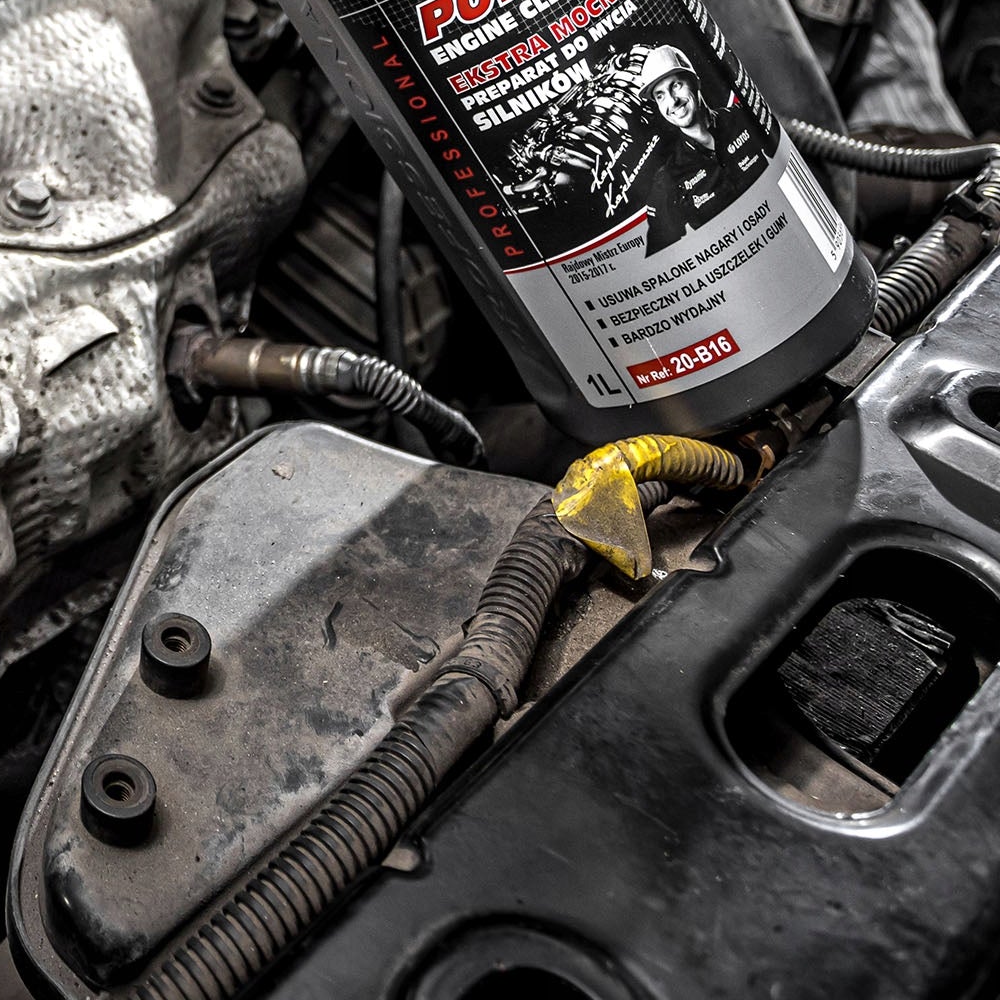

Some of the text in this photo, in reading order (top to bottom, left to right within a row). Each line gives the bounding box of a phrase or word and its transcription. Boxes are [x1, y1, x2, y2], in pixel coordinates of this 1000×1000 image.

[430, 12, 519, 65] ENGINE
[447, 34, 551, 94] EKSTRA
[460, 0, 638, 111] PREPARAT DO MYCIA
[472, 58, 592, 132] SILNIKÓW
[373, 35, 523, 257] PROFESSIONAL
[734, 130, 750, 150] LOTOS
[561, 234, 644, 274] Rajdowy Mistrz Europy
[568, 267, 609, 285] 2015-2017
[598, 284, 642, 309] USUWA
[641, 259, 697, 292] SPALONE
[696, 234, 738, 266] NAGARY
[742, 200, 771, 233] OSADY
[610, 290, 680, 327] BEZPIECZNY
[678, 278, 707, 298] DLA
[706, 239, 764, 284] USZCZELEK
[766, 212, 789, 240] GUMY
[621, 290, 727, 346] BARDZO WYDAJNY
[587, 374, 621, 396] 1L
[636, 336, 732, 386] Nr Ref: 20-B16
